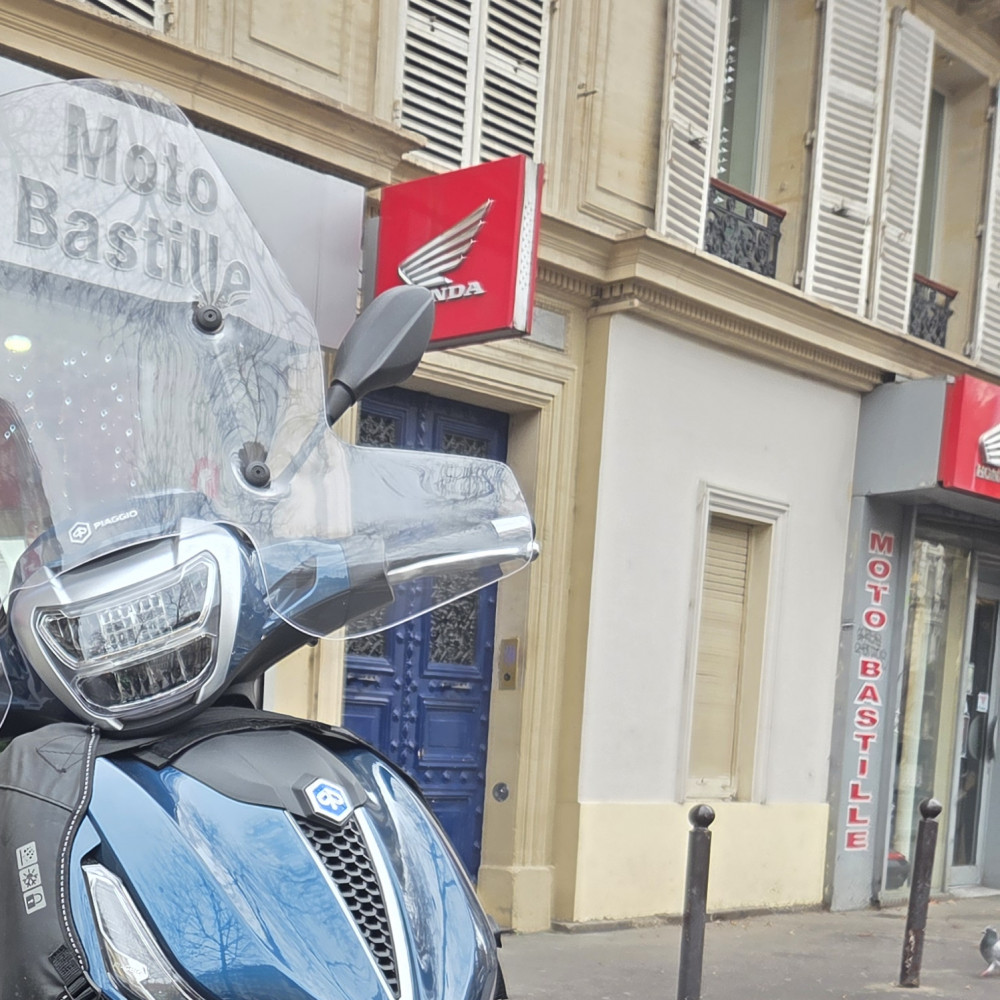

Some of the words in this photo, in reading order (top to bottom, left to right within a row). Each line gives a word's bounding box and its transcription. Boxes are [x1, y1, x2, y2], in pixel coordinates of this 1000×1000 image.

[63, 103, 219, 216] Moto
[14, 175, 251, 308] Bastille
[93, 510, 138, 530] PIAGGIO
[862, 530, 894, 631] MOTO
[845, 657, 882, 851] BASTILLE
